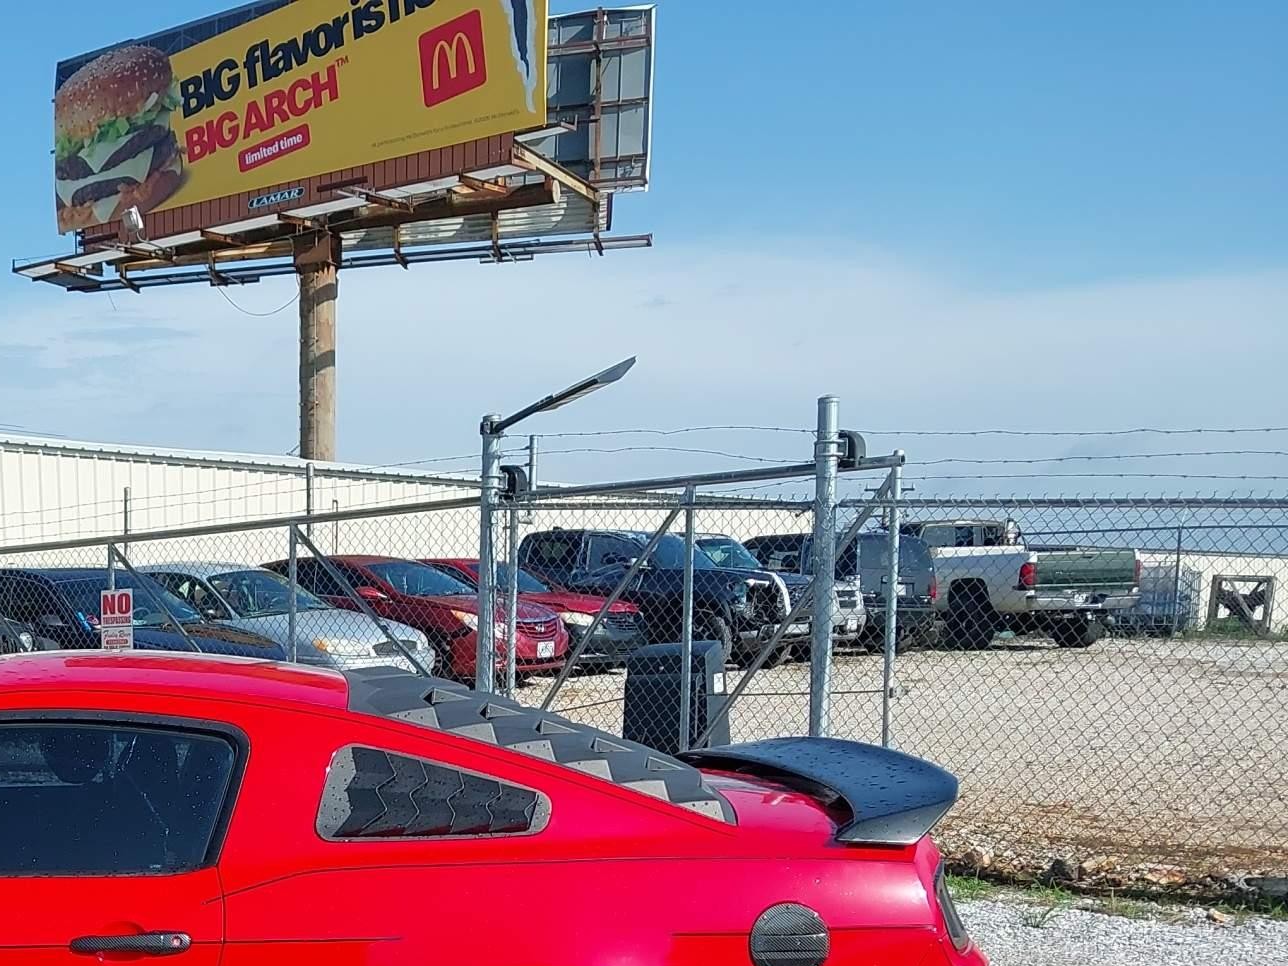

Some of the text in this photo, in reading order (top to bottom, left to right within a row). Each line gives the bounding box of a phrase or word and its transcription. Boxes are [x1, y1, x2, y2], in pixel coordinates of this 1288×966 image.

[180, 0, 386, 119] BIG flavor is
[185, 110, 240, 164] BIG
[244, 131, 304, 165] limited time
[252, 188, 300, 209] LAMAR
[103, 593, 130, 615] NO
